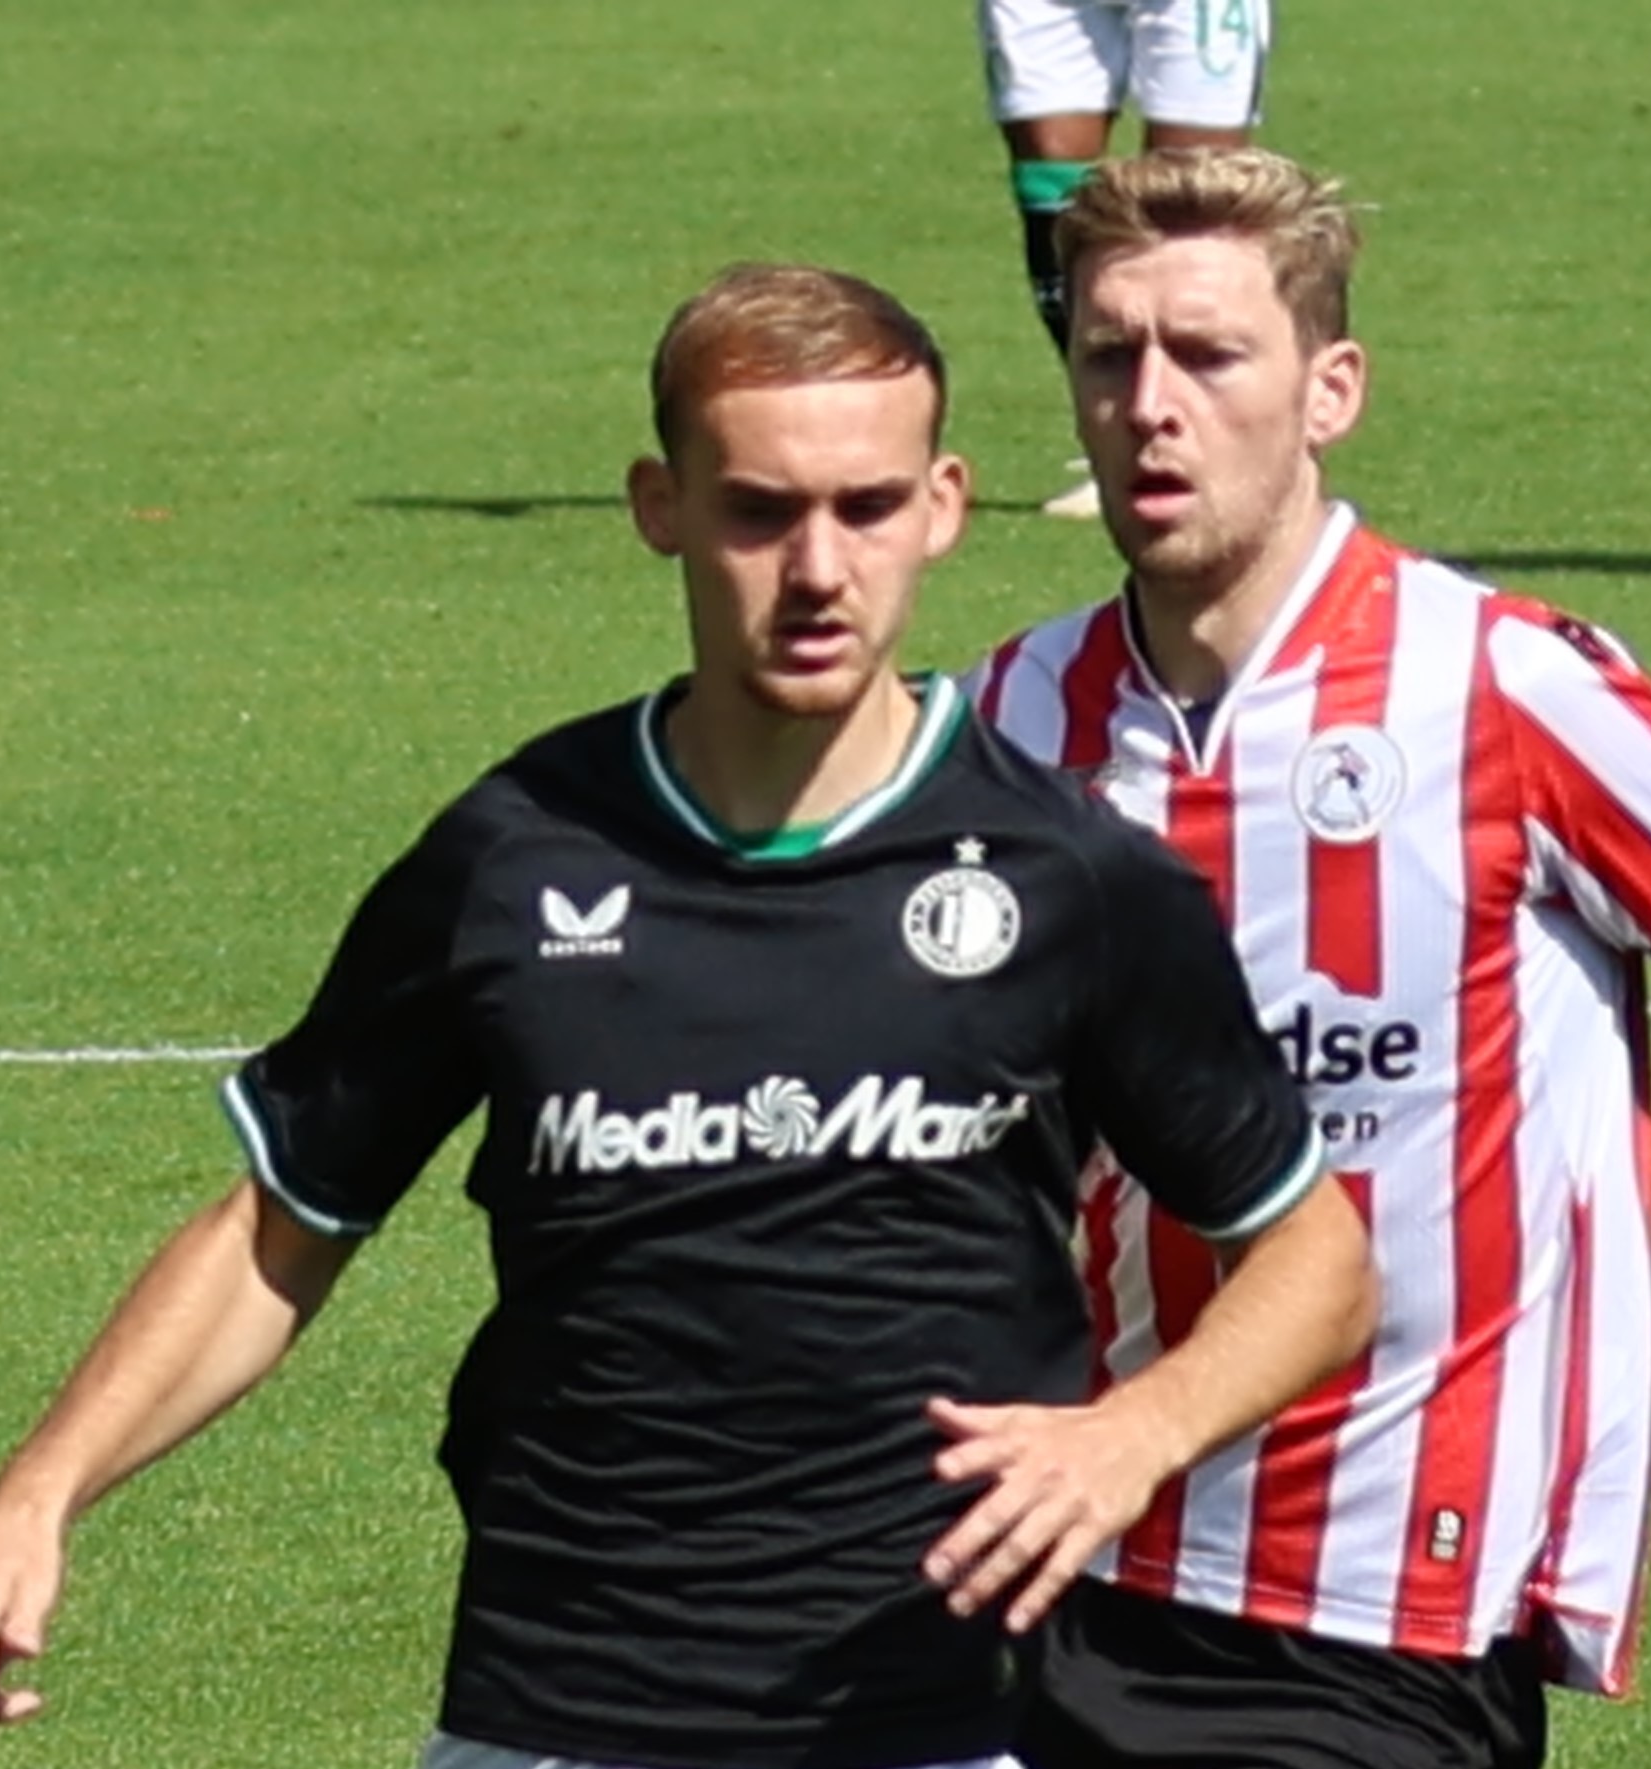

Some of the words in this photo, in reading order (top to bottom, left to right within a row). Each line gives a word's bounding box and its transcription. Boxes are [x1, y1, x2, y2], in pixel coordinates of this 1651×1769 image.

[1274, 1003, 1421, 1084] dse
[528, 1089, 740, 1175] Media
[1316, 1110, 1379, 1143] en
